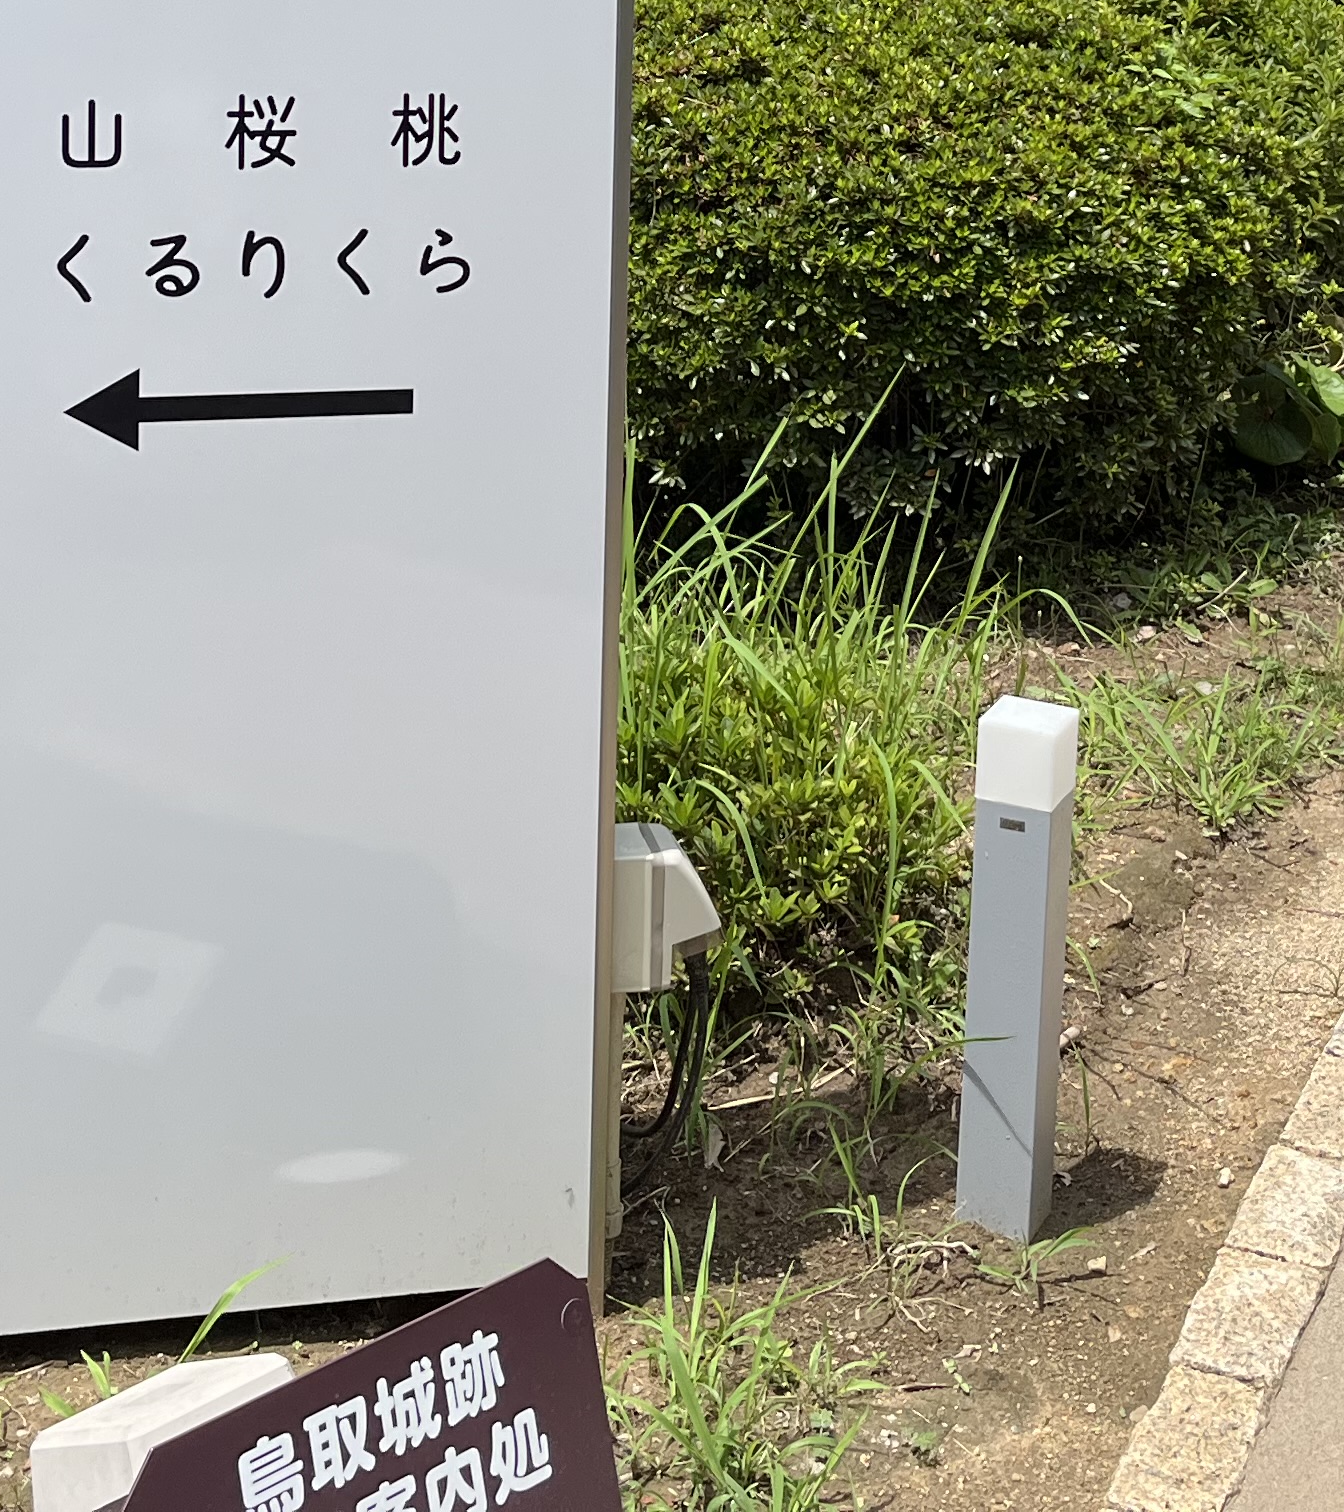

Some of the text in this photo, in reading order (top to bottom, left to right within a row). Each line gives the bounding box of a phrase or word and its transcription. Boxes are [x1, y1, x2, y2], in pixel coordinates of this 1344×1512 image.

[56, 228, 471, 303] くるりくら
[237, 1328, 506, 1512] 鳥取城跡
